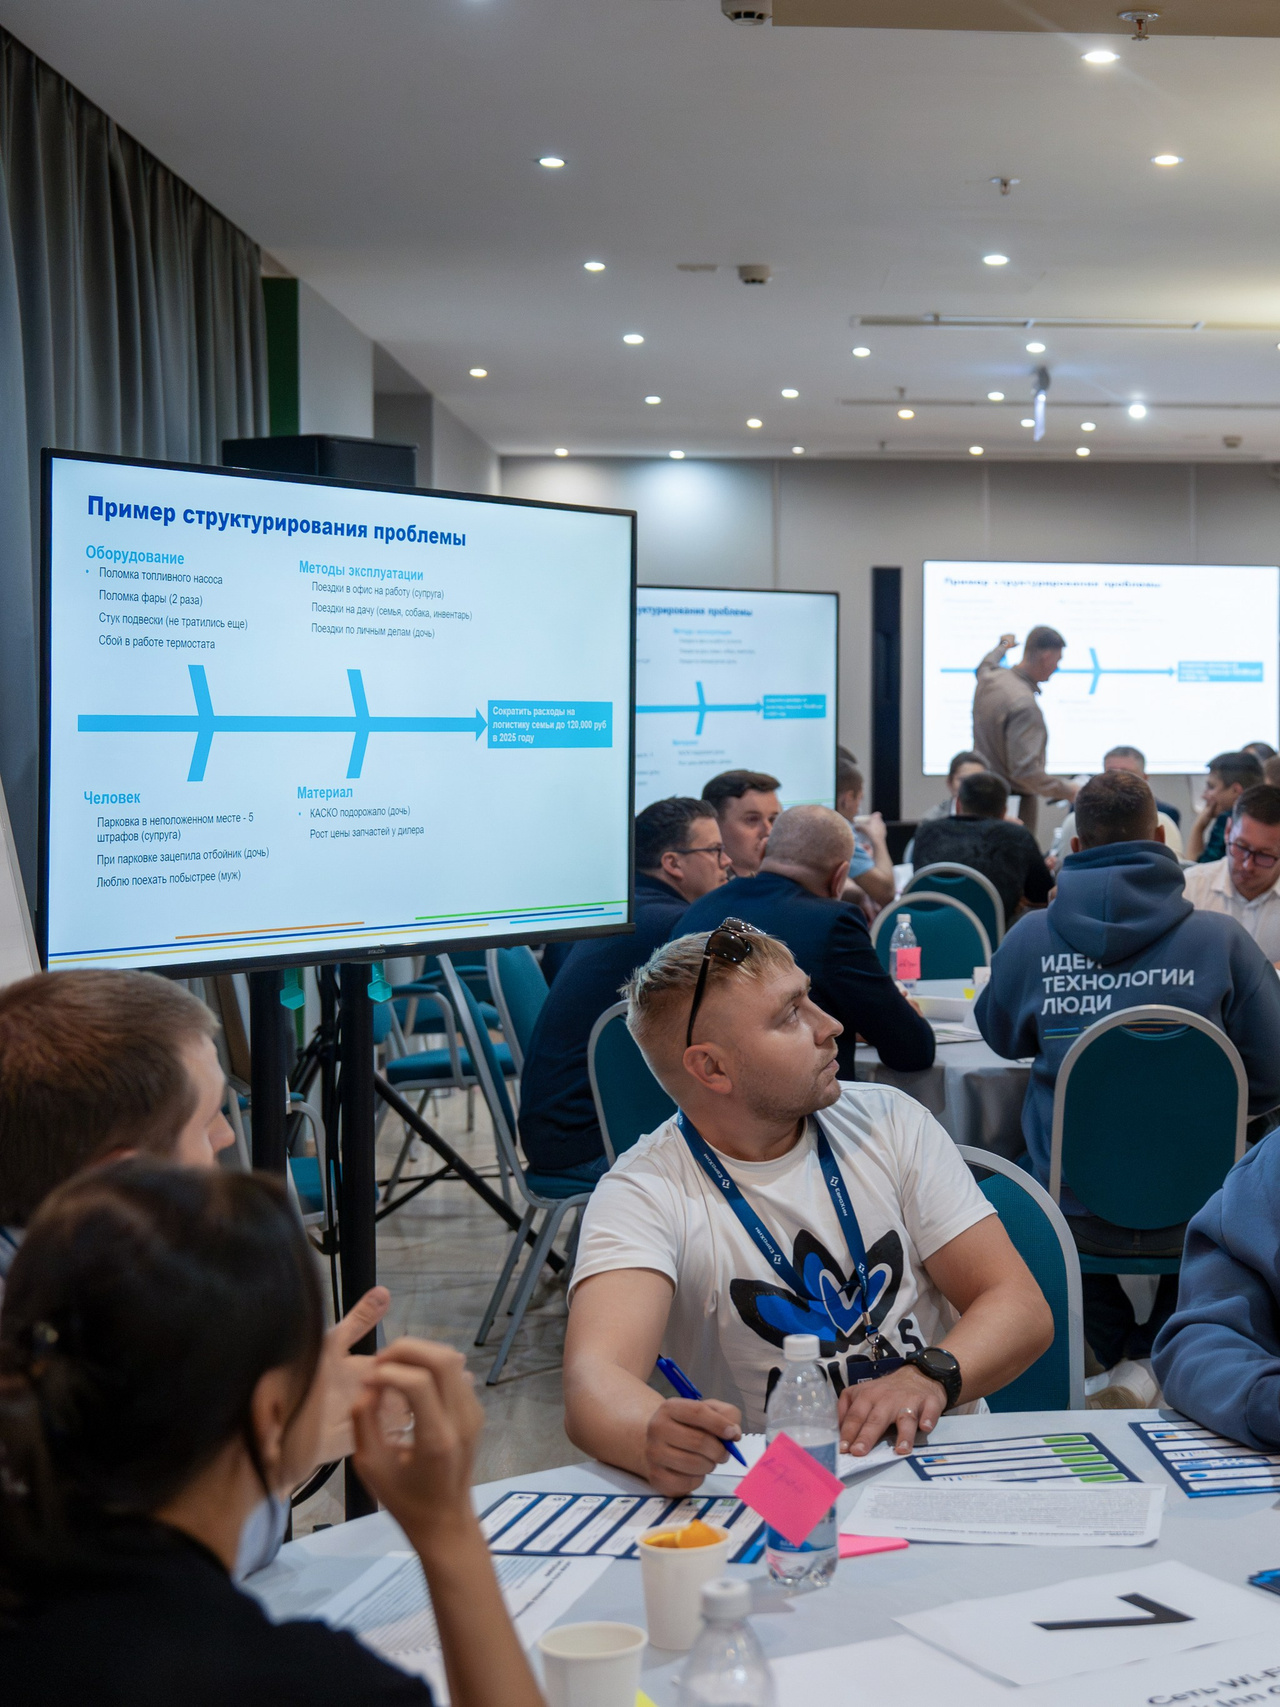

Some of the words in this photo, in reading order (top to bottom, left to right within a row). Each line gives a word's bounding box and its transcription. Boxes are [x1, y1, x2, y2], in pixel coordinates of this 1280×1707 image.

[87, 495, 176, 526] Пример
[182, 509, 368, 538] структурирования
[373, 524, 466, 547] проблемы
[85, 545, 185, 565] Оборудование
[99, 566, 140, 579] Поломка
[141, 571, 192, 582] топливного
[193, 575, 223, 584] насоса
[299, 560, 345, 576] Методы
[348, 566, 424, 581] эксплуатации
[98, 589, 140, 601] Поломка
[140, 591, 167, 604] фары
[168, 593, 178, 605] (2
[179, 595, 203, 606] раза)
[311, 580, 345, 593] Поездки
[345, 585, 351, 593] в
[352, 584, 373, 595] офис
[374, 587, 384, 595] на
[384, 586, 411, 598] работу
[411, 588, 445, 599] (супруга)
[311, 601, 344, 613] Поездки
[345, 605, 356, 613] на
[356, 606, 375, 616] дачу
[376, 606, 404, 616] (семья,
[404, 607, 432, 618] собака,
[433, 610, 473, 620] инвентарь)
[98, 611, 121, 625] Стук
[122, 615, 164, 625] подвески
[165, 615, 180, 627] (не
[181, 617, 226, 628] тратились
[227, 619, 248, 630] еще)
[311, 622, 344, 634] Поездки
[345, 626, 355, 634] по
[356, 626, 386, 635] личным
[386, 628, 411, 636] делам
[412, 628, 436, 638] (дочь)
[98, 634, 123, 645] Сбой
[124, 637, 131, 646] в
[132, 636, 164, 648] работе
[165, 639, 216, 649] термостата
[492, 706, 532, 717] Сократить
[533, 708, 566, 718] расходы
[566, 708, 576, 716] на
[492, 721, 530, 731] логистику
[531, 721, 555, 729] семьи
[555, 721, 566, 730] до
[567, 720, 593, 731] 120,000
[593, 720, 607, 731] руб
[492, 734, 498, 742] в
[499, 733, 517, 742] 2025
[517, 734, 535, 744] году
[83, 790, 141, 804] Человек
[297, 786, 353, 800] Материал
[97, 816, 140, 829] Парковка
[141, 817, 148, 826] в
[149, 815, 214, 825] неположенном
[215, 814, 242, 823] месте
[248, 811, 254, 822] 5
[309, 807, 339, 817] КАСКО
[339, 808, 387, 818] подорожало
[387, 805, 411, 817] (дочь)
[96, 831, 139, 843] штрафов
[141, 829, 182, 842] (супруга)
[309, 828, 329, 838] Рост
[330, 829, 351, 838] цены
[351, 826, 390, 836] запчастей
[391, 827, 397, 837] у
[397, 826, 425, 836] дилера
[96, 854, 116, 866] При
[117, 854, 158, 865] парковке
[159, 852, 201, 862] зацепила
[202, 848, 242, 859] отбойник
[243, 847, 270, 859] (дочь)
[96, 875, 130, 887] Люблю
[131, 875, 168, 885] поехать
[169, 872, 216, 883] побыстрее
[217, 870, 242, 882] (муж)
[1042, 968, 1195, 994] ТЕХНОЛОГИИ
[1041, 994, 1112, 1016] ЛЮДИ
[1147, 1686, 1219, 1706] Сеть
